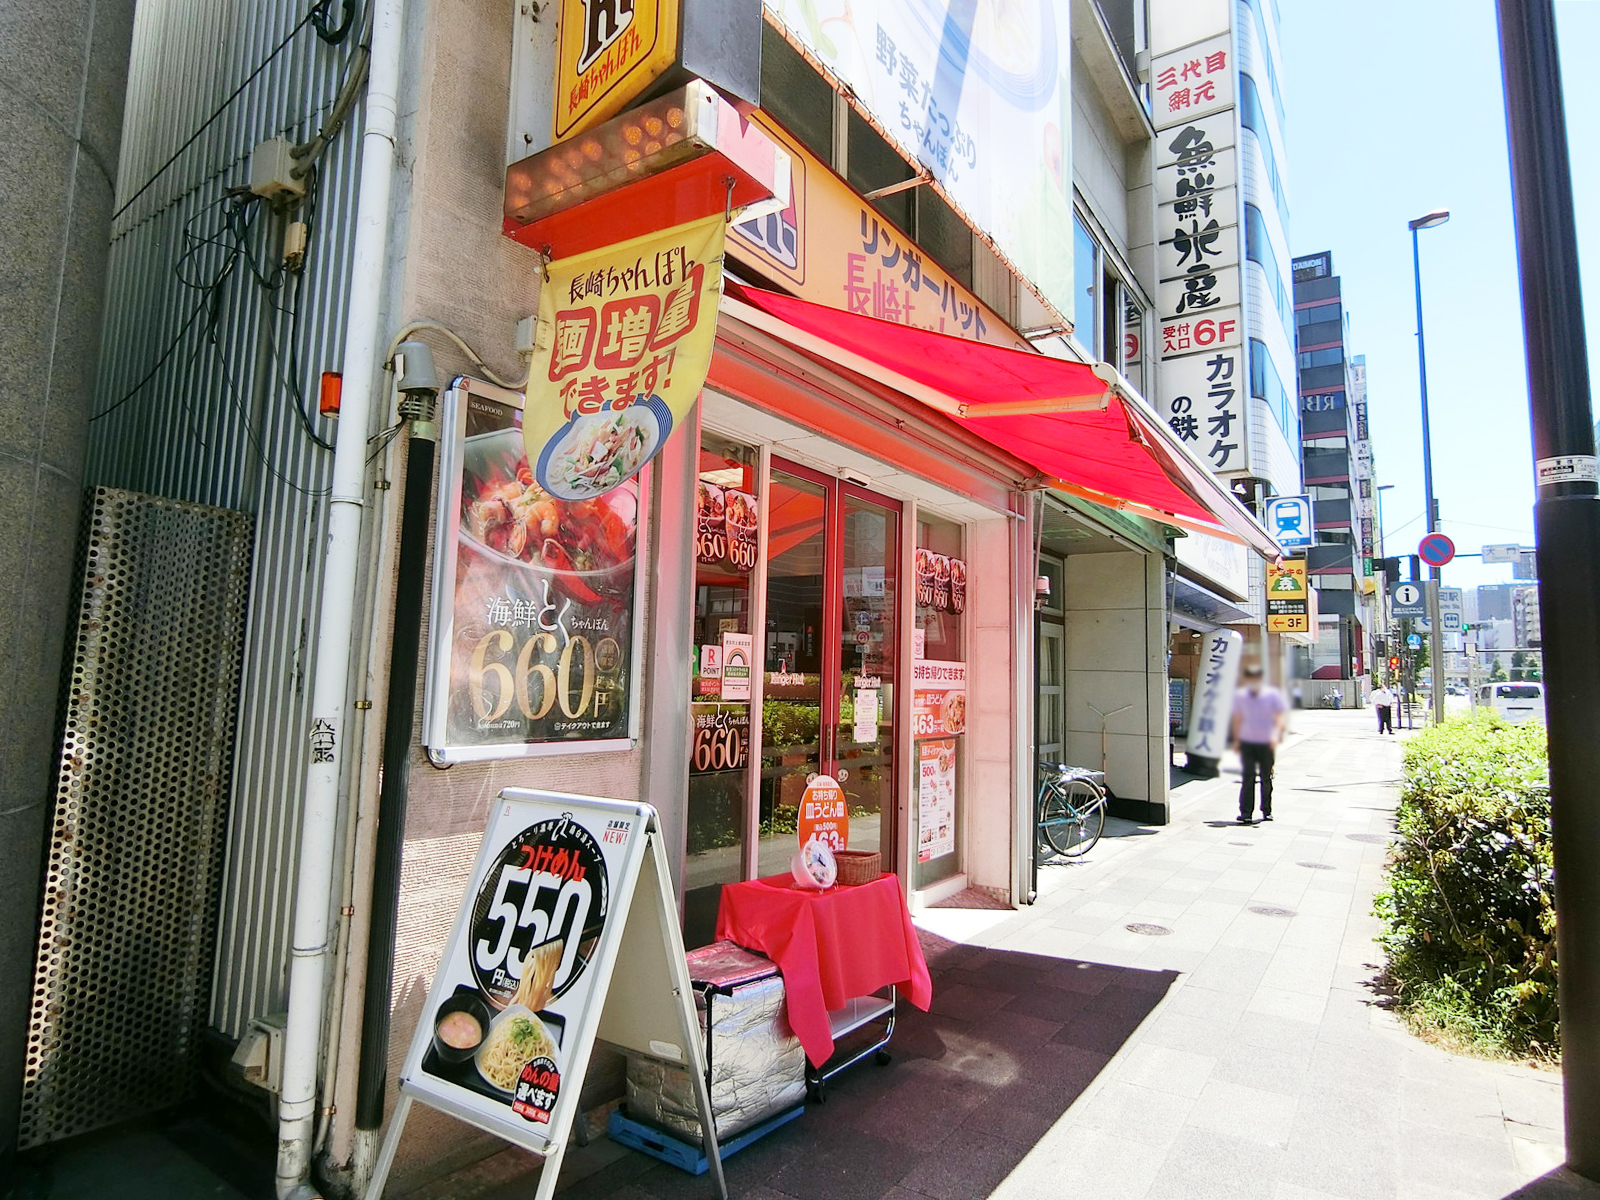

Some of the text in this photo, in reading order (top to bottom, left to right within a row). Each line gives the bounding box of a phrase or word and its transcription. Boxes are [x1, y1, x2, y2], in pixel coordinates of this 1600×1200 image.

[568, 25, 642, 117] 長崎ちゃんぽん
[1156, 50, 1227, 91] 三代目
[876, 22, 976, 170] 野菜たっぷり
[1168, 80, 1216, 113] 網元
[1168, 125, 1222, 314] 魚鮮水産
[568, 245, 697, 305] 長崎ちゃんぽん
[860, 208, 987, 341] リンガーハット
[1163, 323, 1191, 338] 受付
[1163, 338, 1191, 353] 入口
[1193, 318, 1236, 346] 6F
[559, 346, 677, 420] できます!
[470, 401, 503, 416] SEAFOOD
[1206, 353, 1238, 468] カラオケ
[730, 539, 755, 568] 660
[1485, 548, 1517, 556] 大門
[1277, 576, 1295, 591] 森
[1287, 618, 1302, 627] 3F
[703, 667, 720, 675] POINT
[708, 648, 716, 663] R
[468, 629, 595, 721] 660
[694, 728, 741, 771] 660
[812, 789, 838, 801] お持ち帰り
[602, 830, 628, 846] NEW!
[517, 843, 587, 884] つけめん
[476, 864, 592, 989] 550
[516, 1081, 556, 1111] 選べます
